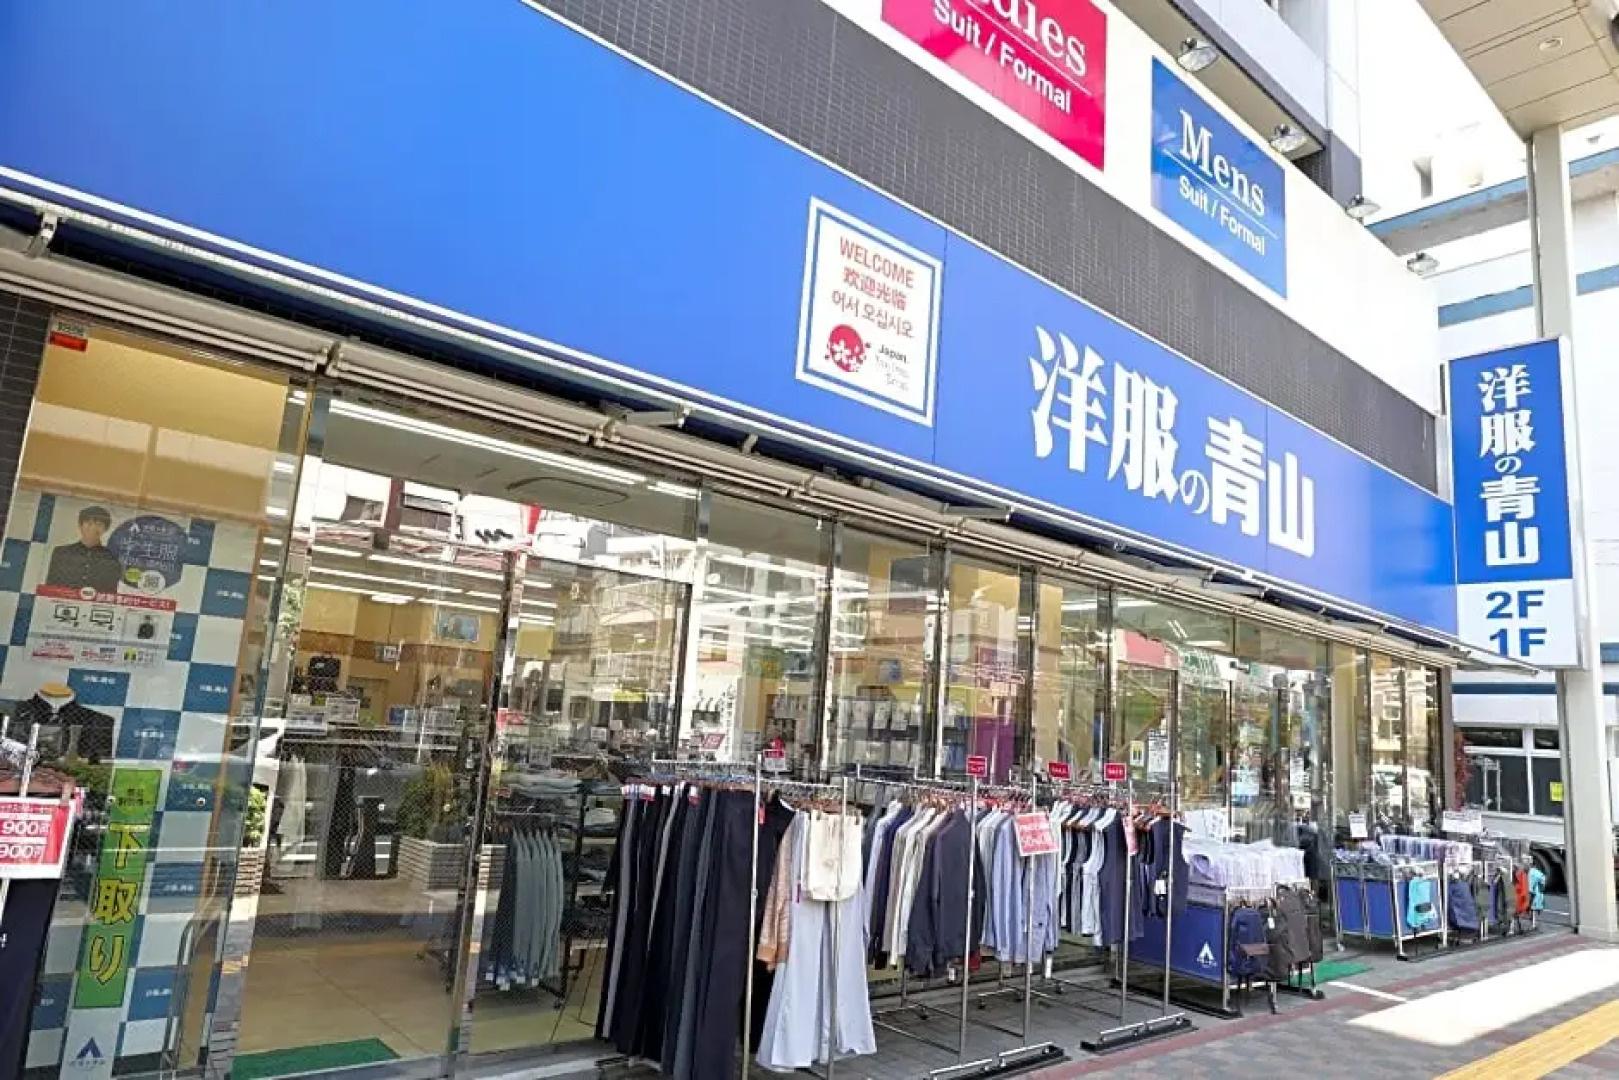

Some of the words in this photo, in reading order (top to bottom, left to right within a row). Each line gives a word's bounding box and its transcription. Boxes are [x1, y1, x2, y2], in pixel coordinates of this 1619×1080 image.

[933, 0, 981, 49] Suit
[985, 33, 997, 56] /
[1000, 41, 1072, 114] Formal
[978, 0, 1087, 77] dies
[1180, 107, 1265, 216] Mens
[1179, 175, 1208, 214] Suit
[1210, 200, 1219, 218] /
[1220, 205, 1265, 256] Formal
[840, 236, 914, 288] WELCOME
[843, 266, 907, 312] 欢迎光临
[832, 290, 860, 317] 어서
[1028, 324, 1315, 559] 洋服の青山
[1478, 364, 1541, 567] 洋服の青山
[1486, 590, 1544, 619] 2F
[1489, 628, 1547, 658] 1F
[89, 821, 152, 985] 下取り
